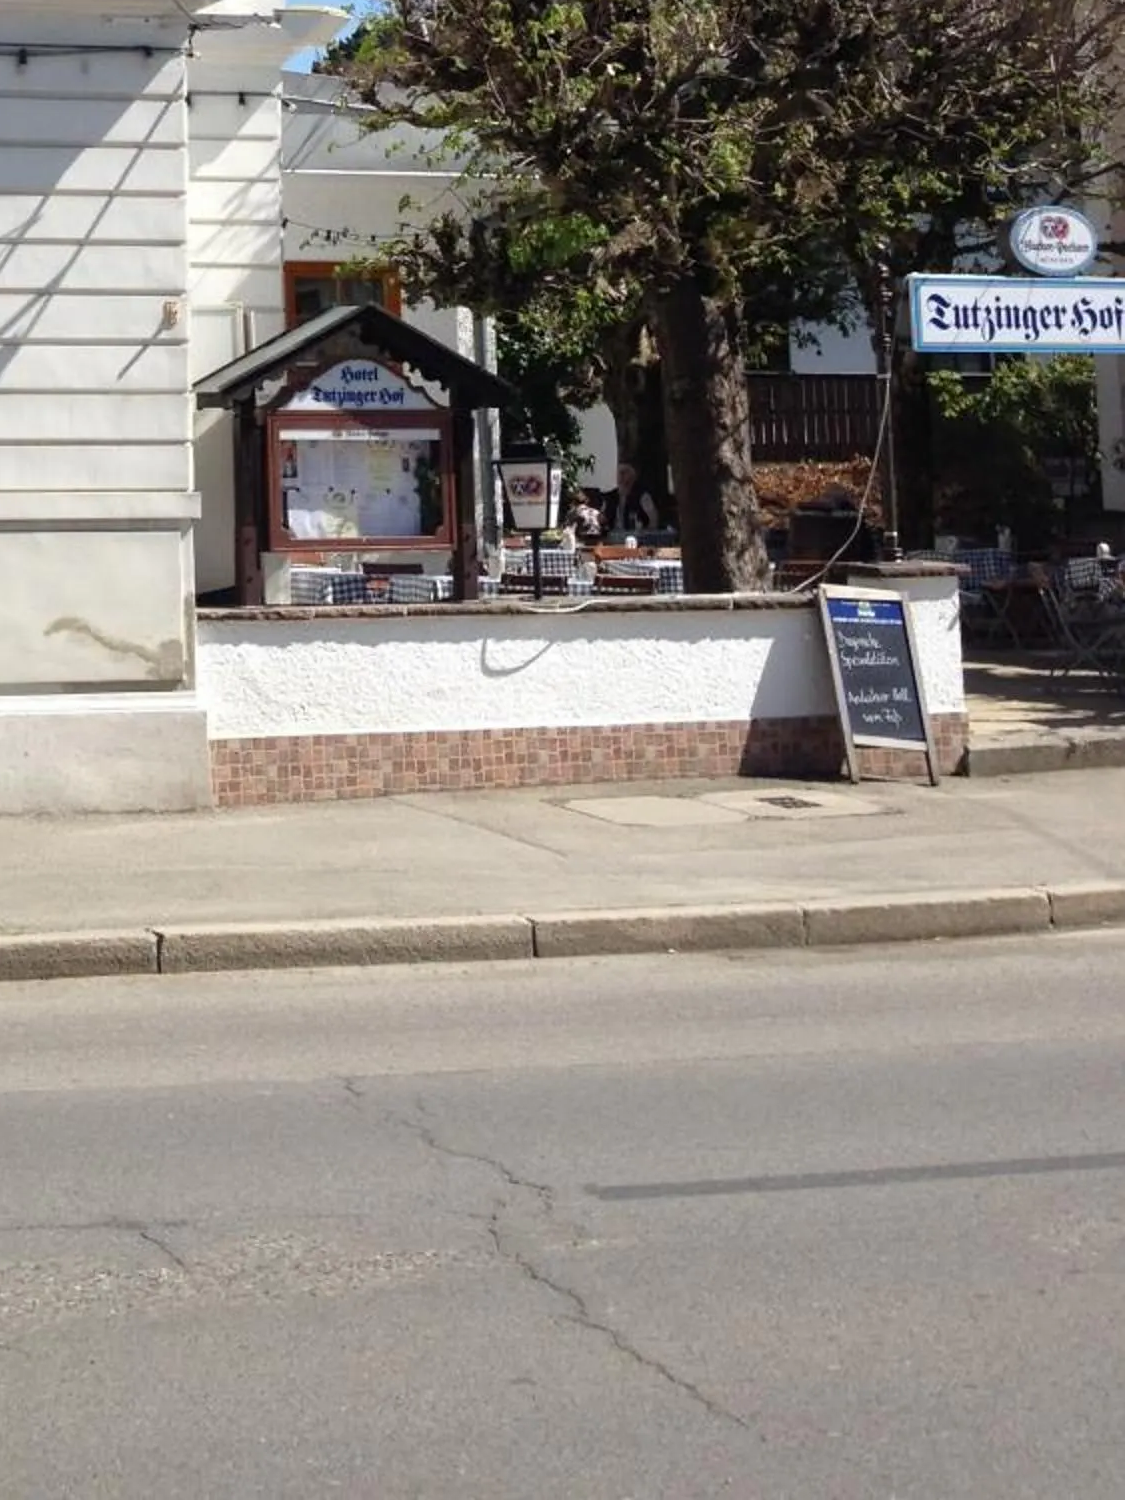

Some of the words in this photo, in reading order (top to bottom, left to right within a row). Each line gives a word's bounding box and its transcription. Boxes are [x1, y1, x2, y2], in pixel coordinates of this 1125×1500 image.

[927, 293, 1067, 342] Tutzinger
[1071, 296, 1125, 342] Hof
[340, 366, 378, 384] Hotel
[312, 386, 377, 408] Tutzinger
[379, 387, 405, 405] Hof
